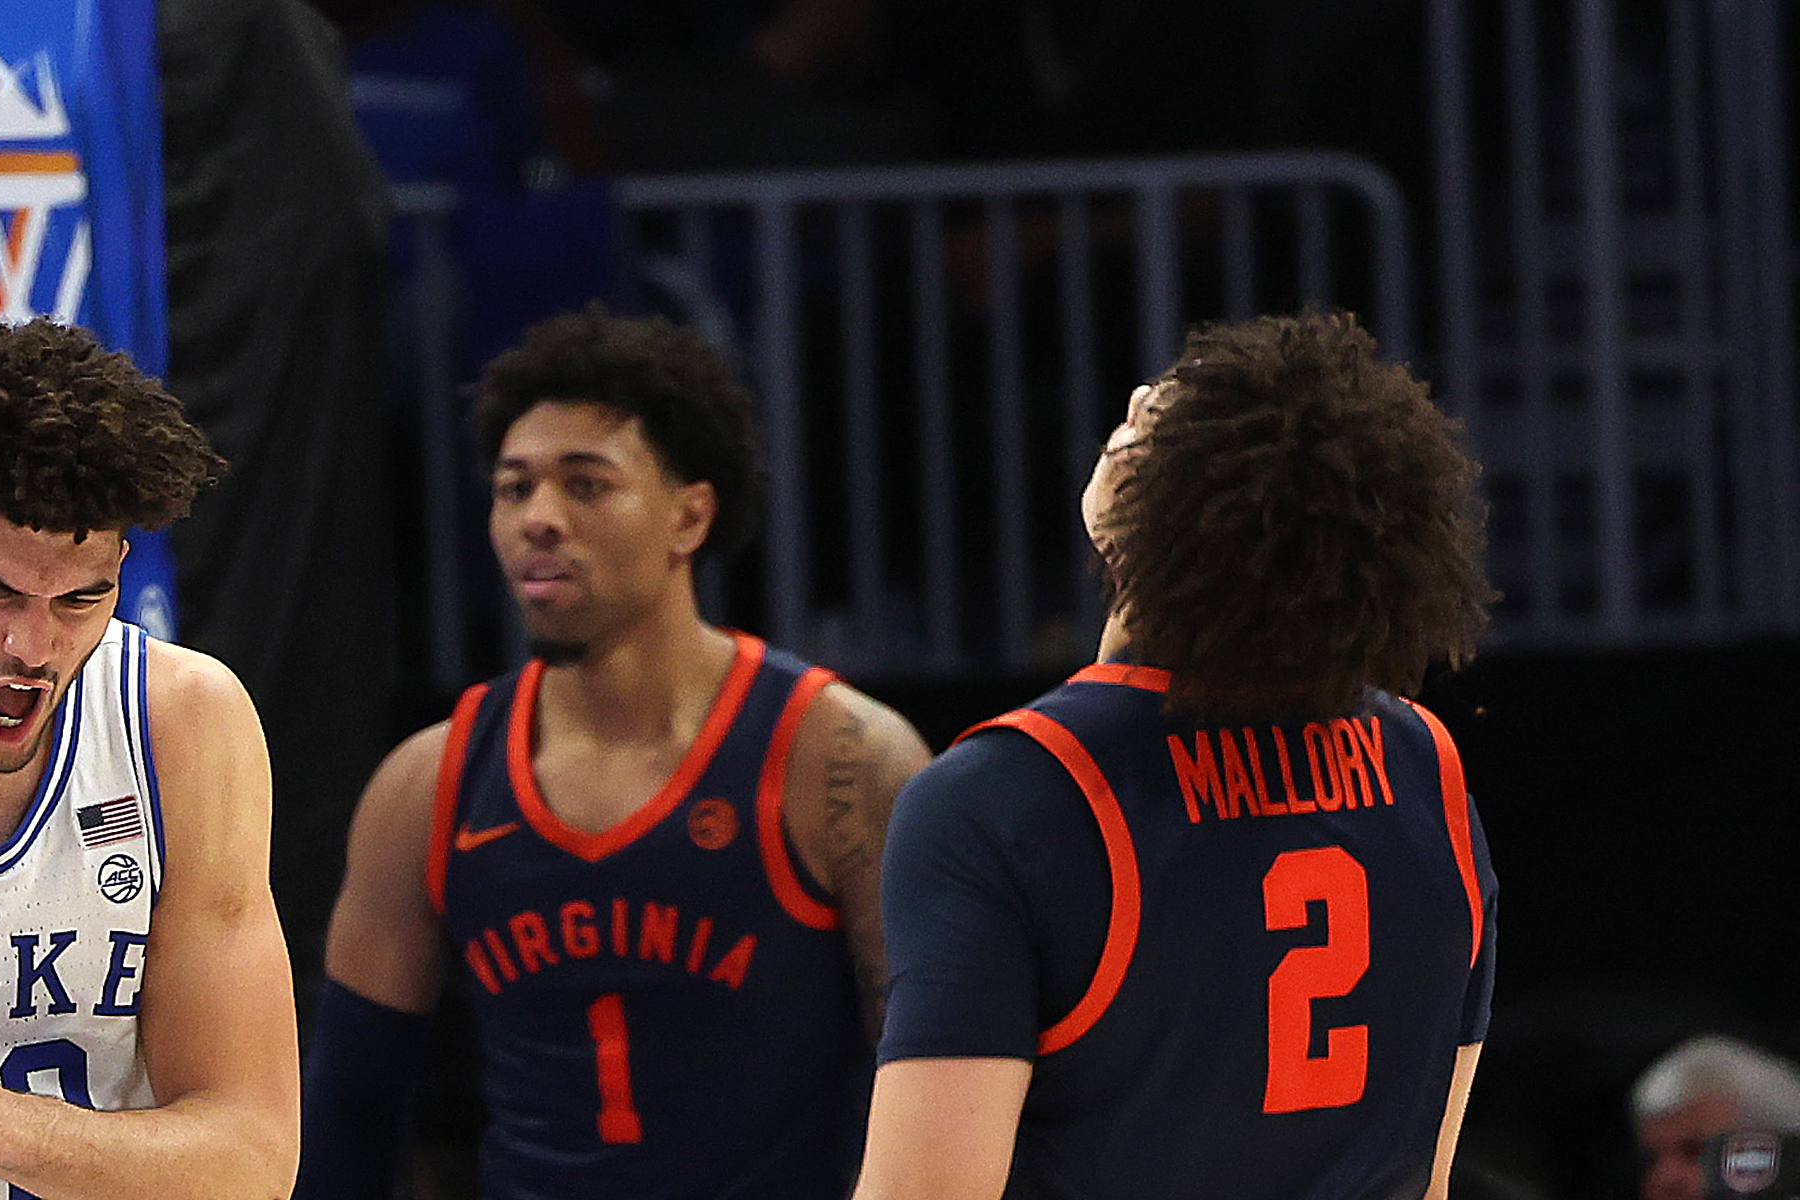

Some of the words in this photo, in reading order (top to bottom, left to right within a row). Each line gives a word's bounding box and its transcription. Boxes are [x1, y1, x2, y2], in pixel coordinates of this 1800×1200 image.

[1166, 715, 1394, 824] MALLORY
[1261, 845, 1371, 1115] 2
[587, 993, 643, 1144] 1
